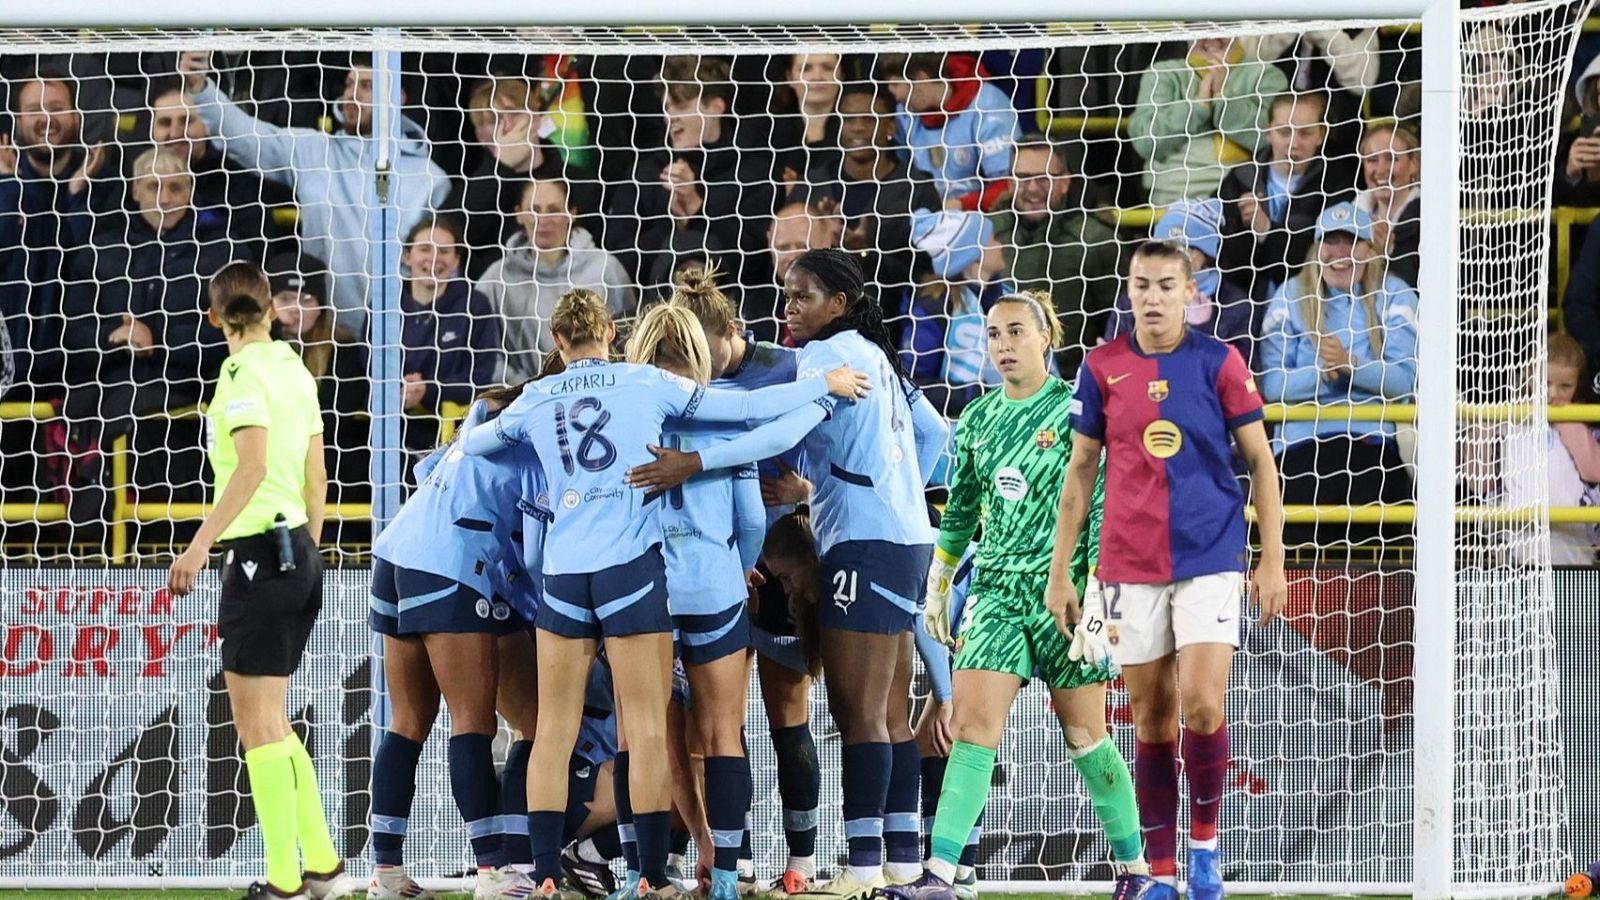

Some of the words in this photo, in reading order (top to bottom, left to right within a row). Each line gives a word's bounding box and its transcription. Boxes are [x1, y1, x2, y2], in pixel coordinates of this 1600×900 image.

[550, 373, 616, 396] CASPARIJ
[554, 396, 617, 477] 18
[21, 585, 175, 615] SUPER
[832, 569, 858, 602] 21
